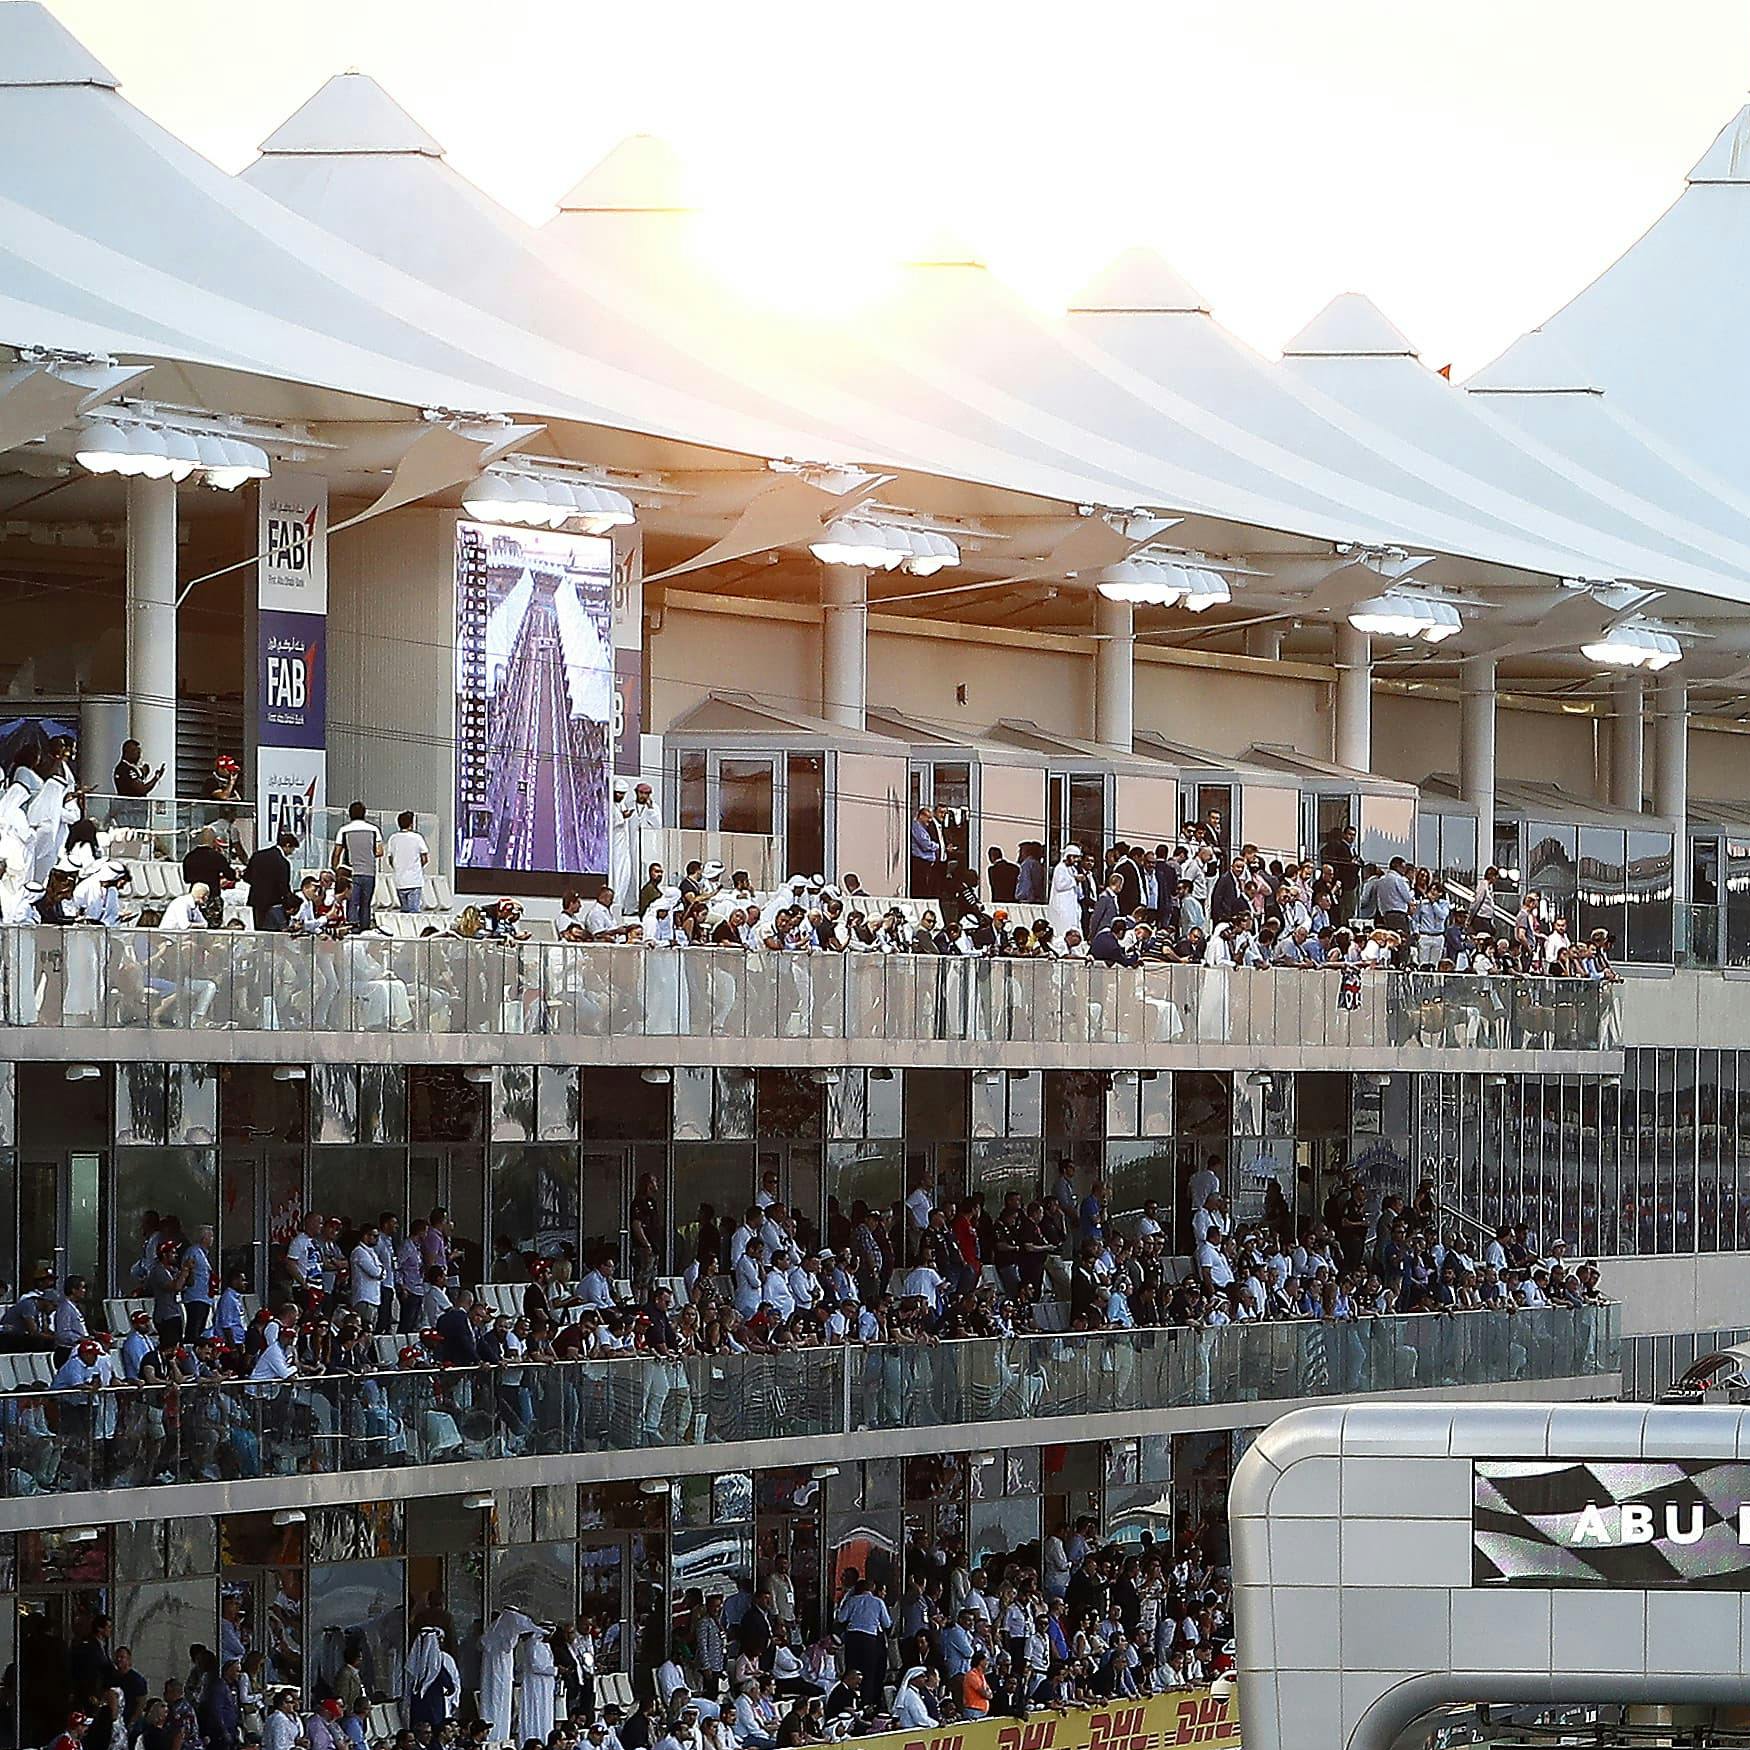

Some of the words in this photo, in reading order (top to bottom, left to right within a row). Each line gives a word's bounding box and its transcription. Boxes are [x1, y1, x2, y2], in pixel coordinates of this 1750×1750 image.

[268, 519, 305, 569] FAB
[267, 656, 305, 708] FAB
[1571, 1498, 1706, 1547] ABU
